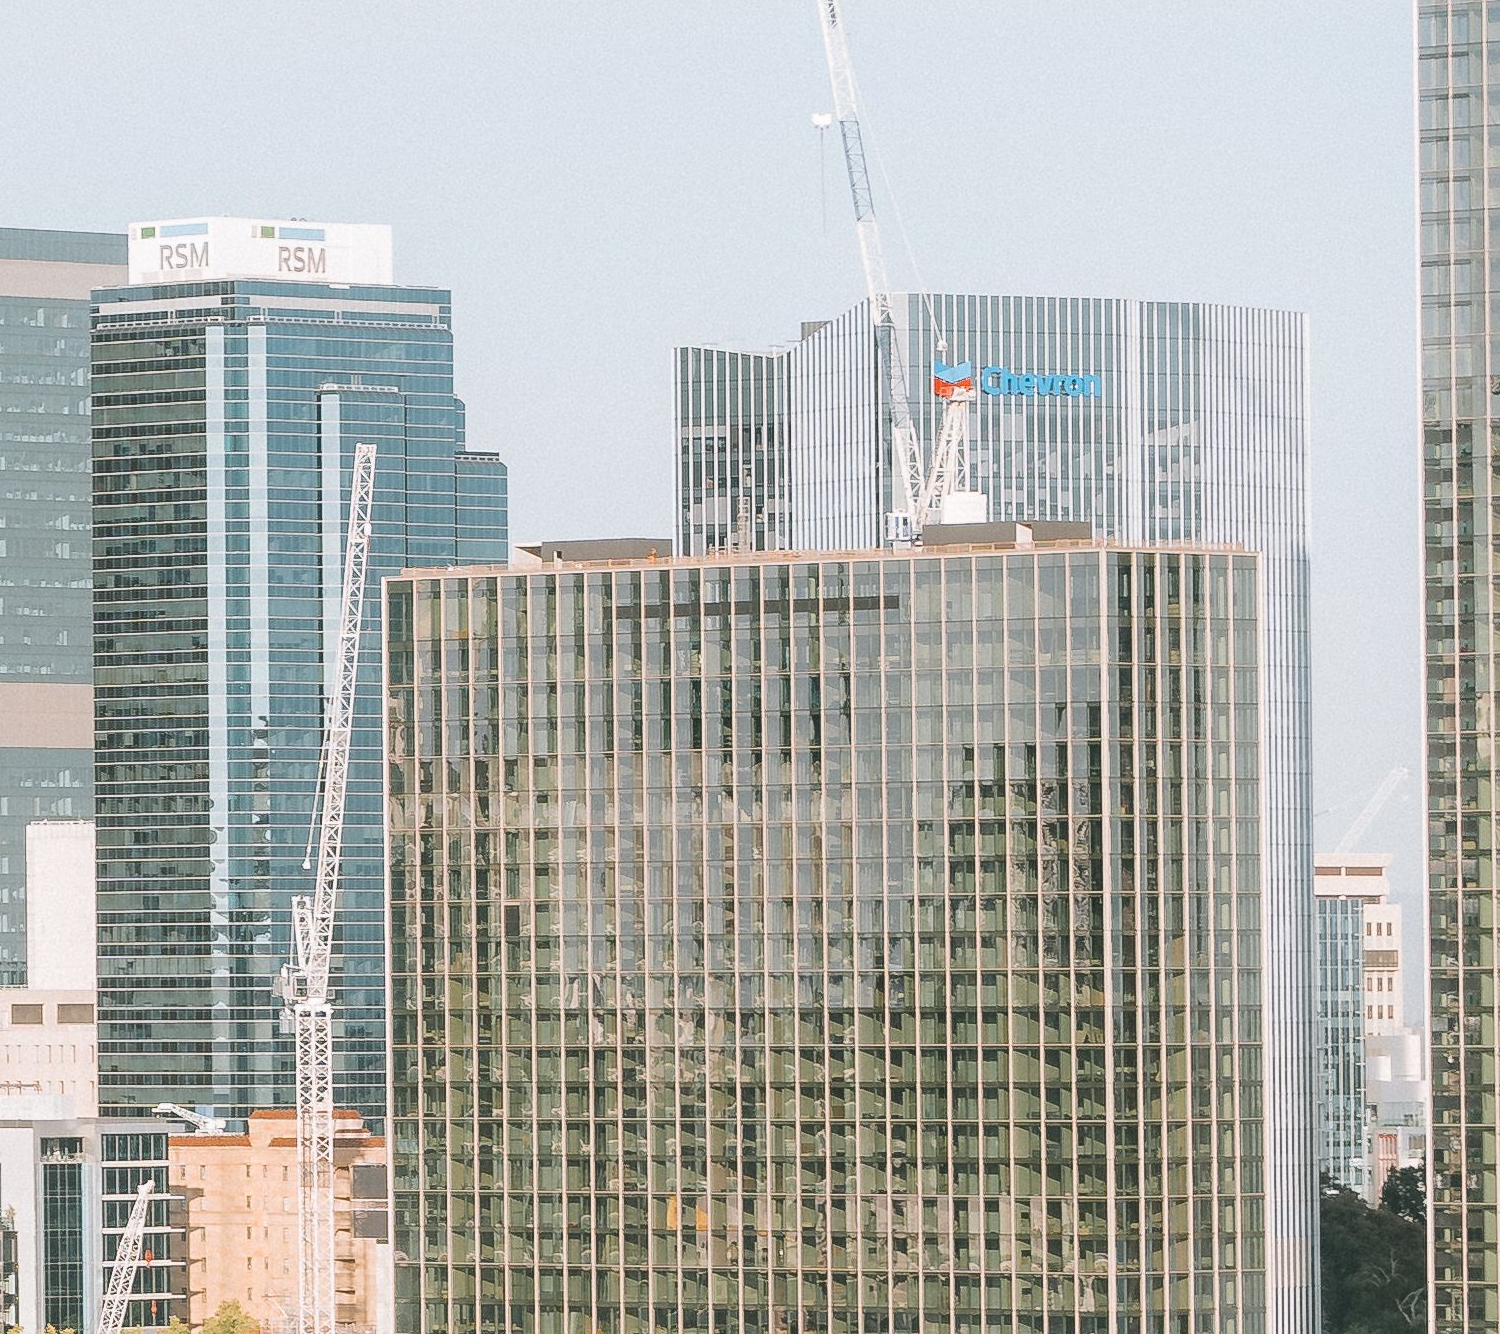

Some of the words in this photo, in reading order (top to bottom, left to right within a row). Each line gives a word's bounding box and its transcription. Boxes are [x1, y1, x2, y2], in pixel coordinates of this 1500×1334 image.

[159, 242, 209, 270] RSM
[278, 246, 326, 274] RSM
[981, 365, 1101, 398] Chevron
